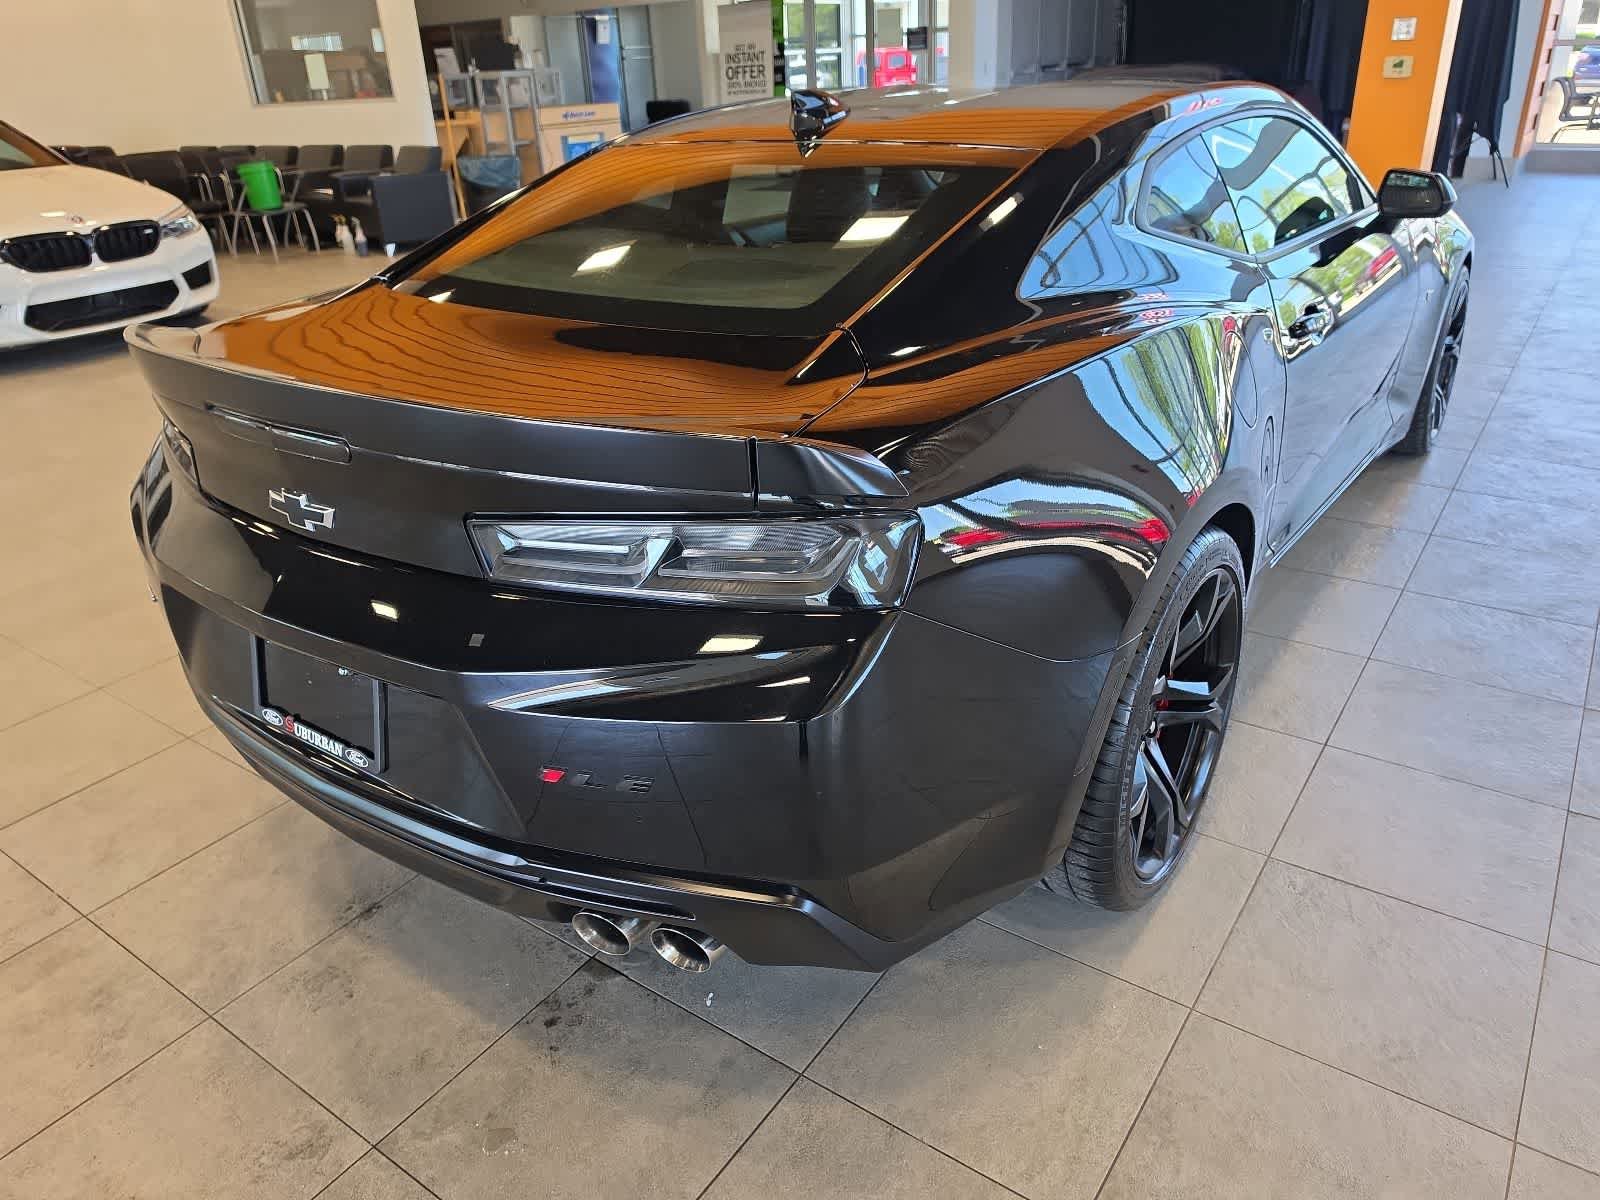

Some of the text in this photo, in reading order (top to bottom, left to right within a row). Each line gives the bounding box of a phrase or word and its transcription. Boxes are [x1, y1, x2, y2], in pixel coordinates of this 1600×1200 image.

[725, 51, 766, 64] INSTANT
[726, 65, 766, 80] OFFER
[285, 715, 343, 757] SUBURBAN
